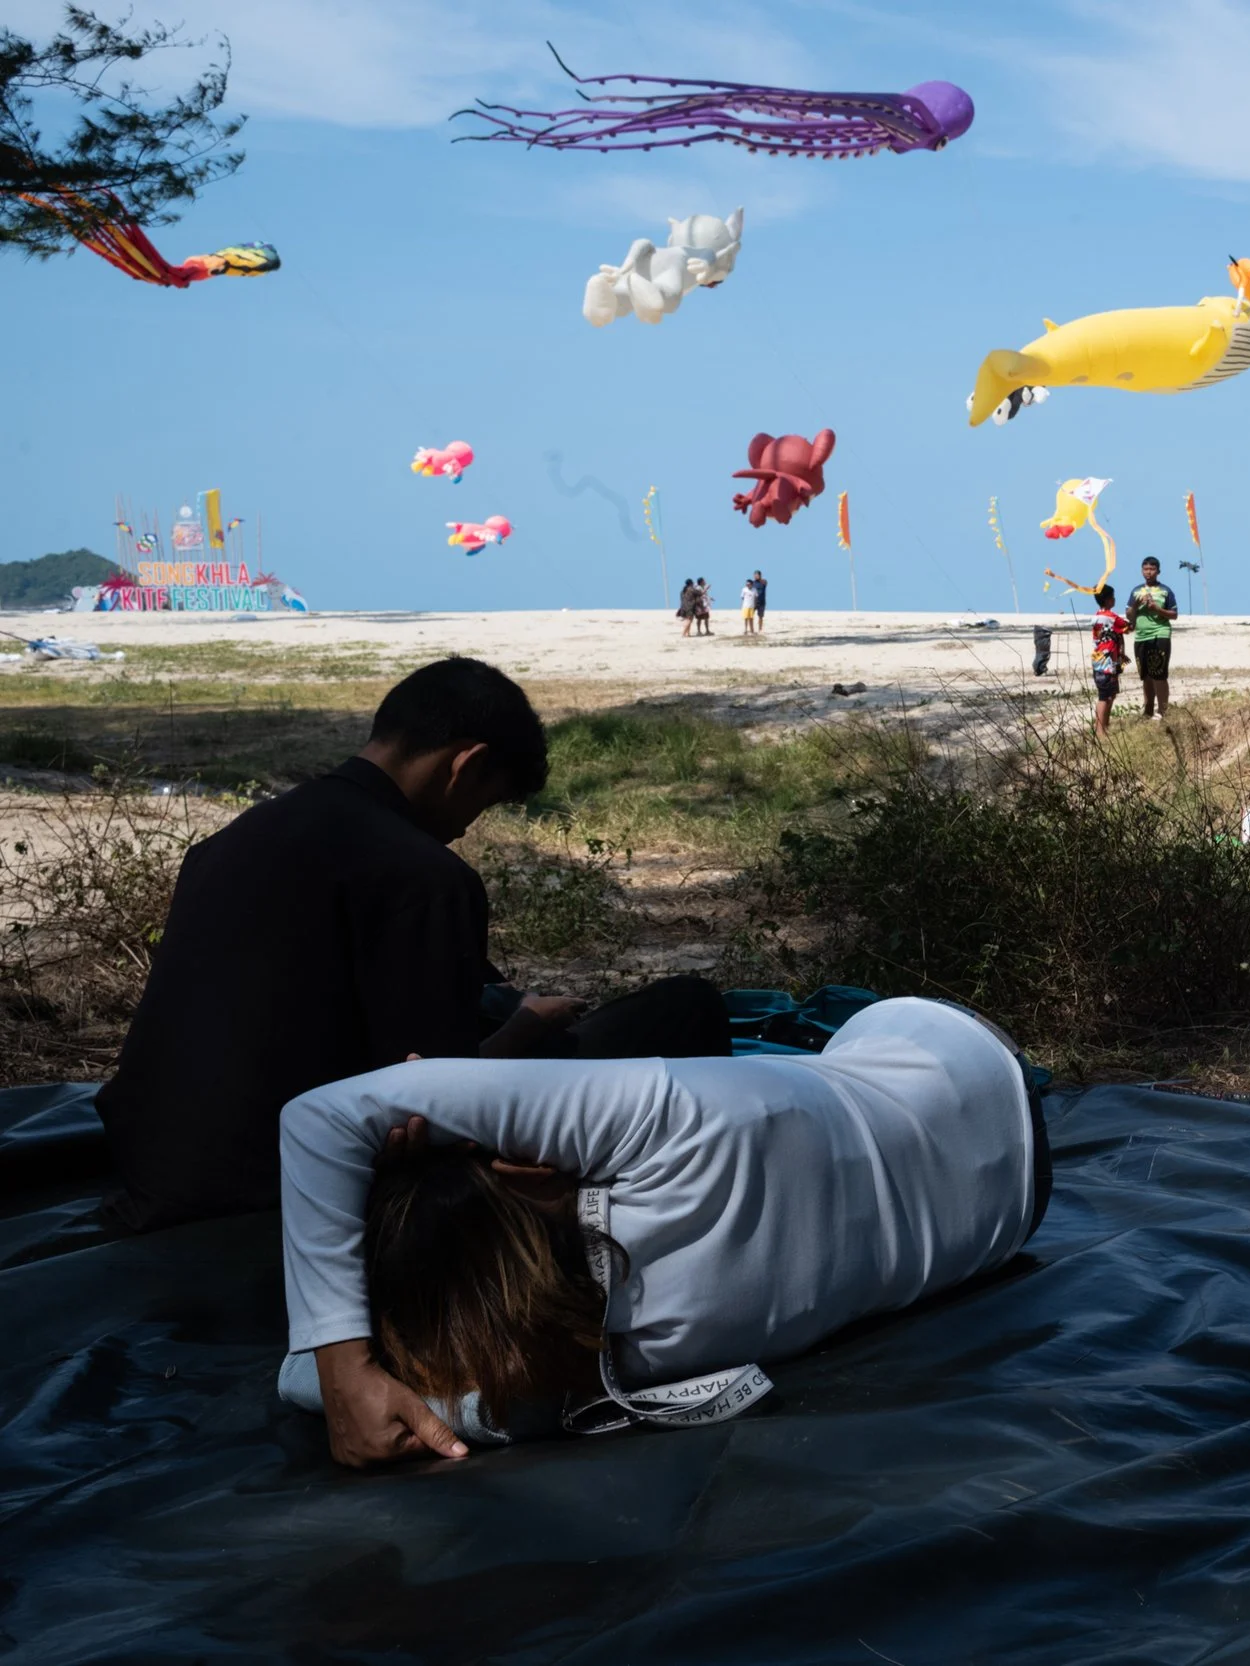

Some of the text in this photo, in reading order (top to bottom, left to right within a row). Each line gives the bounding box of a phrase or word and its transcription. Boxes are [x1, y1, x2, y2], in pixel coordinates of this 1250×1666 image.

[138, 563, 251, 585] SONGKHLA
[171, 587, 267, 611] FESTIVAL
[586, 1190, 600, 1216] LIFE
[666, 1378, 729, 1399] HAPPY
[734, 1383, 753, 1402] BE
[668, 1399, 731, 1422] HAPPY
